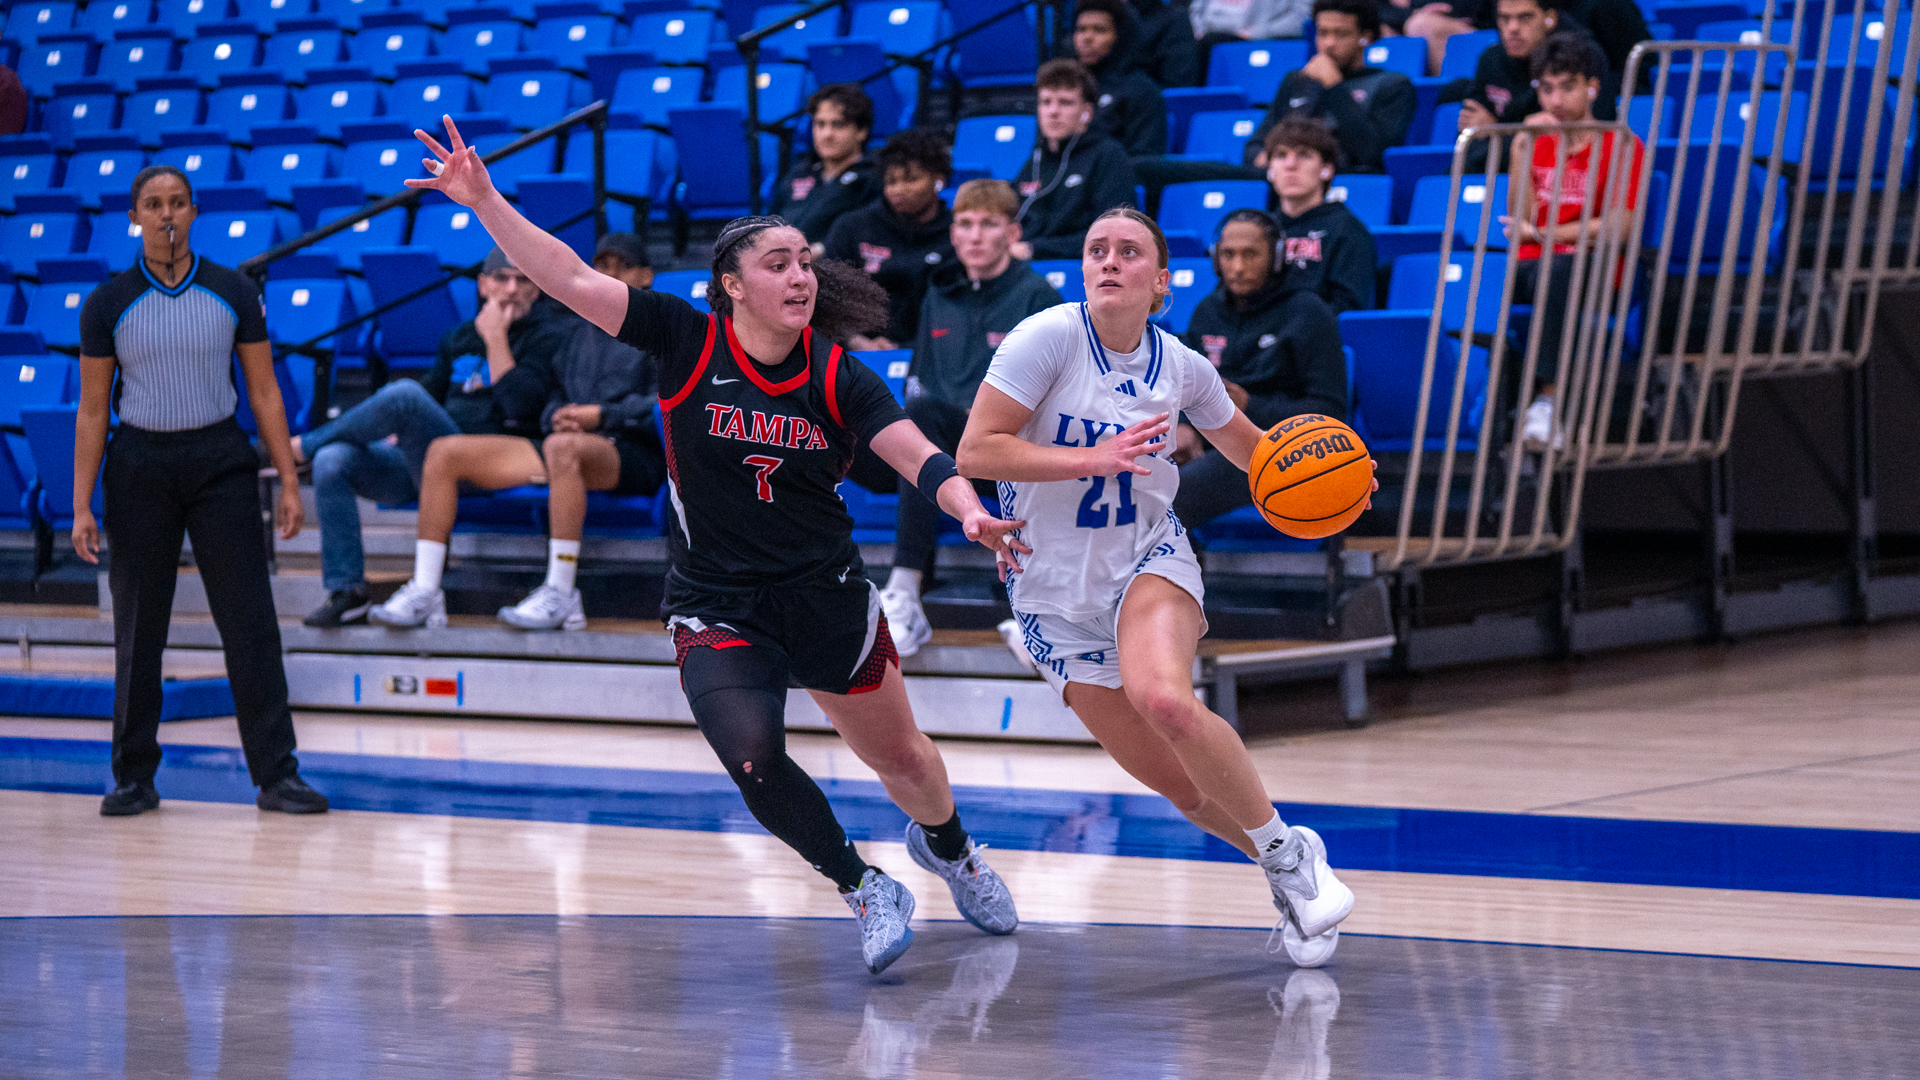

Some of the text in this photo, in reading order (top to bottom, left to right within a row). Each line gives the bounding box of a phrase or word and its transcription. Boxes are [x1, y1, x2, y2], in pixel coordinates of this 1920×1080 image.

[705, 402, 829, 450] TAMPA
[1268, 415, 1326, 443] NCAA
[1275, 433, 1356, 472] Wilson
[742, 454, 784, 503] 7
[1076, 470, 1137, 529] 21
